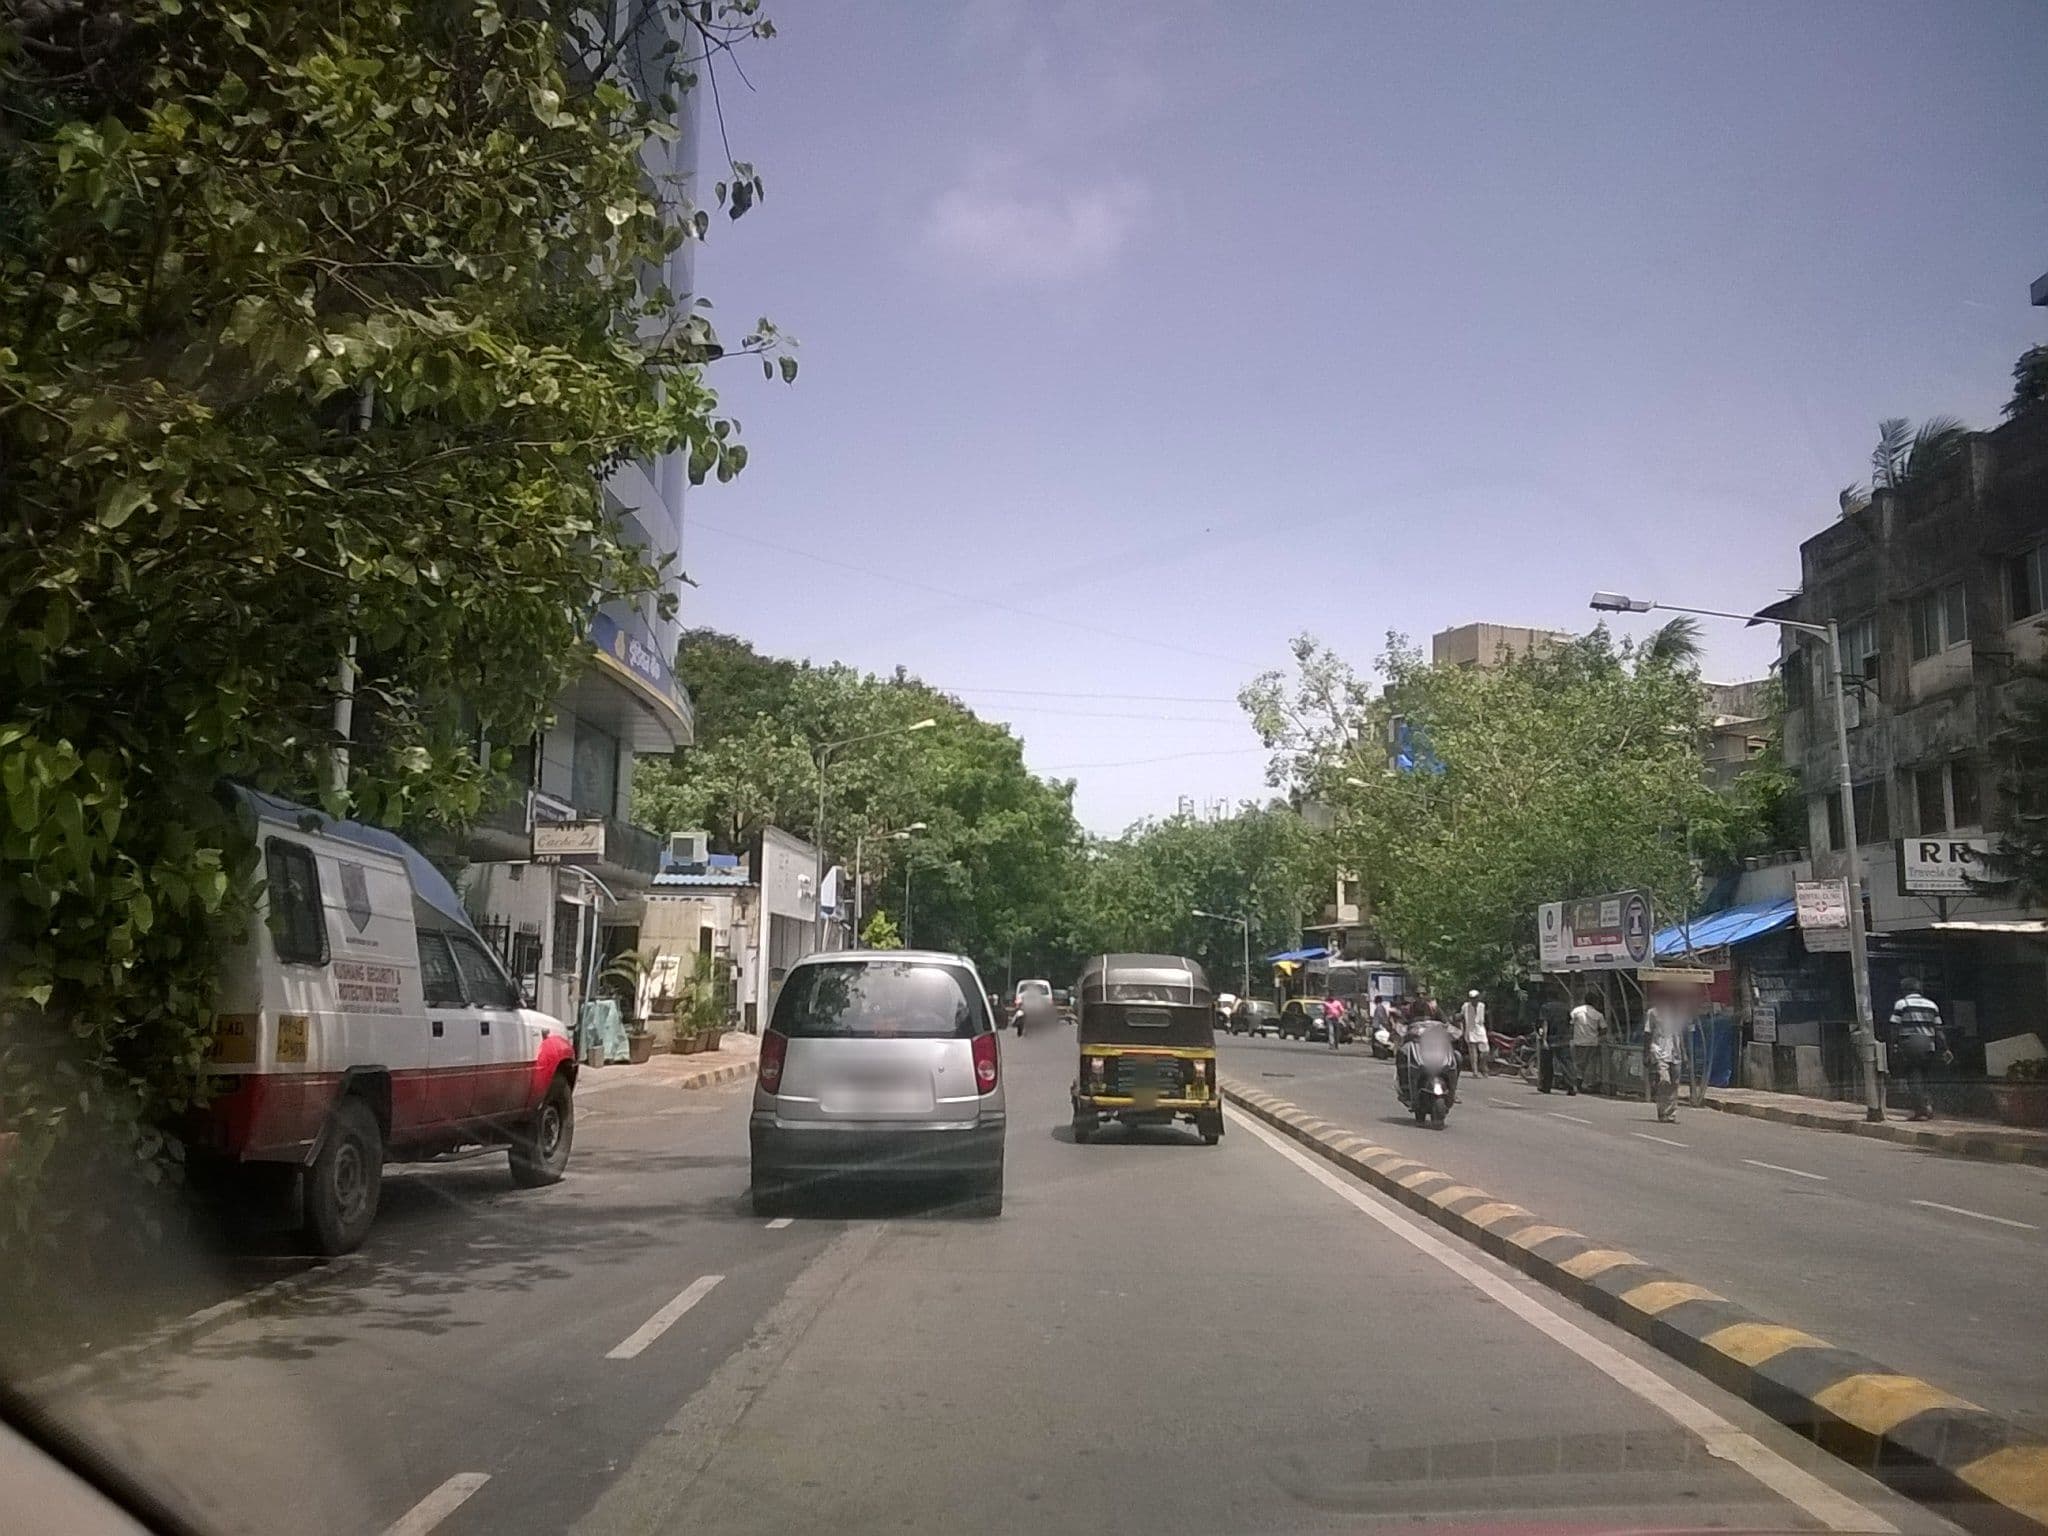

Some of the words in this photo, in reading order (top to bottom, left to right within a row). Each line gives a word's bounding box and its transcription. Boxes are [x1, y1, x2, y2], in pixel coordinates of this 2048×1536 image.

[556, 822, 585, 832] ATM
[1919, 842, 1942, 863] R
[536, 855, 560, 863] ATM
